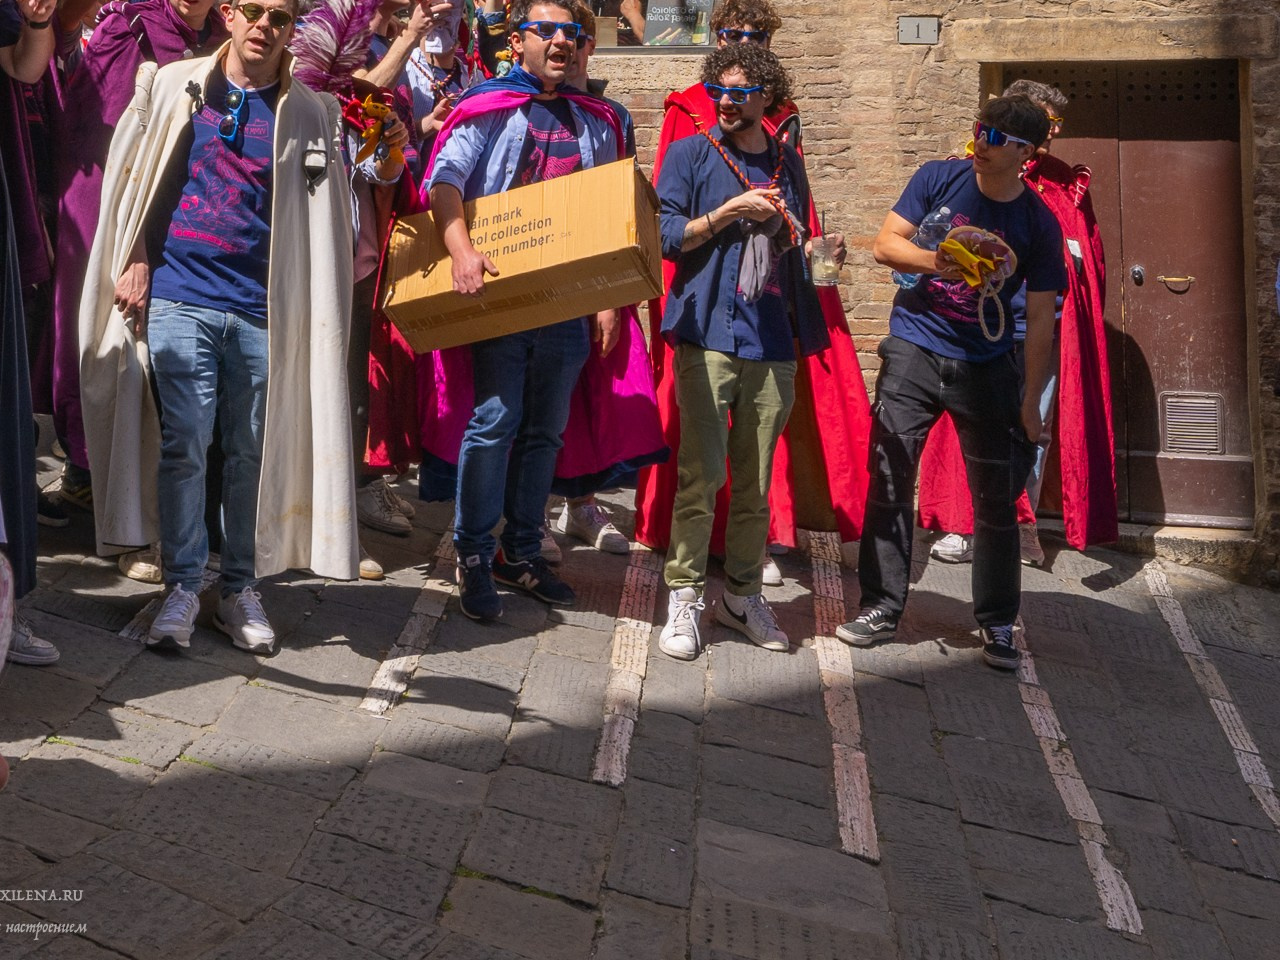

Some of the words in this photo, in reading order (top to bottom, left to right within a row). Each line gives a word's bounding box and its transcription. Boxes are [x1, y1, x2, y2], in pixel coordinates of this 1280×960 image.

[915, 23, 921, 39] 1
[469, 217, 489, 230] ain
[492, 207, 522, 224] mark
[470, 232, 487, 247] ool
[490, 217, 552, 242] collection
[502, 233, 555, 255] number:
